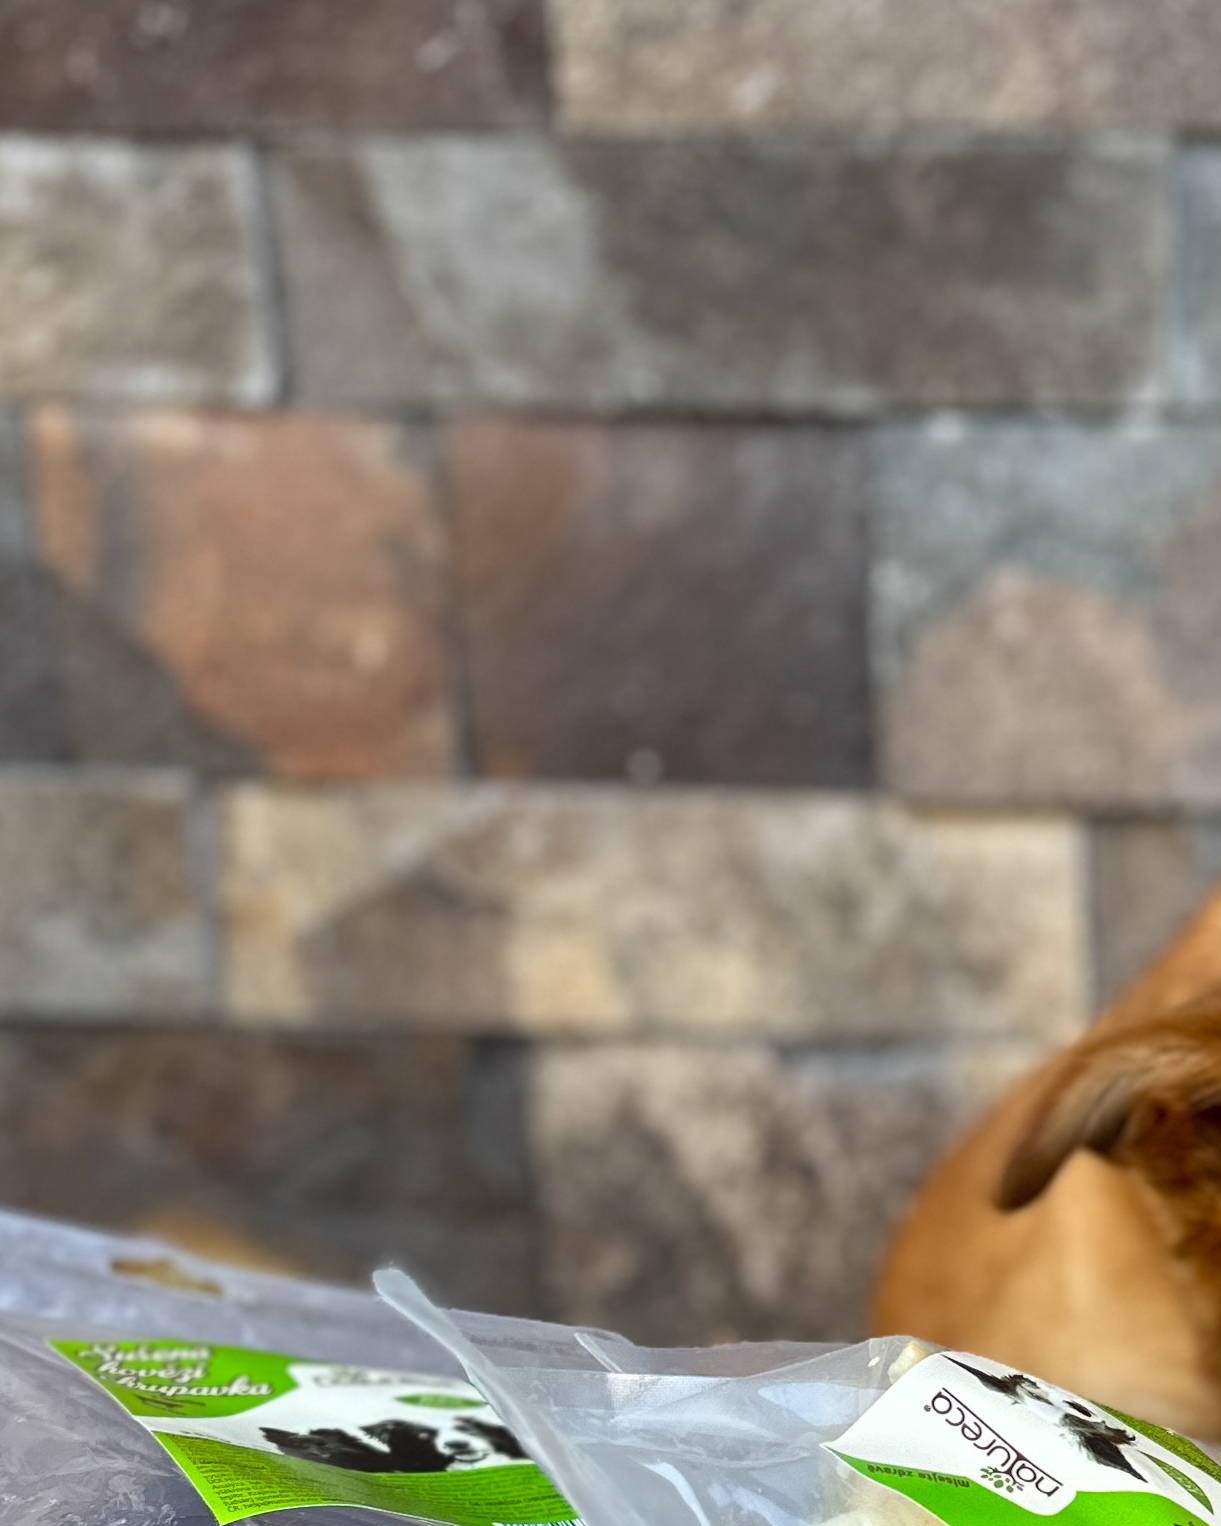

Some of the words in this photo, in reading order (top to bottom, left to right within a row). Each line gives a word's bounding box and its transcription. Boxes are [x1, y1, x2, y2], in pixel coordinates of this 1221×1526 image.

[98, 1360, 208, 1384] hovězí
[98, 1375, 274, 1397] hrupavka
[930, 1390, 1061, 1497] natureca
[868, 1464, 913, 1479] zdravě
